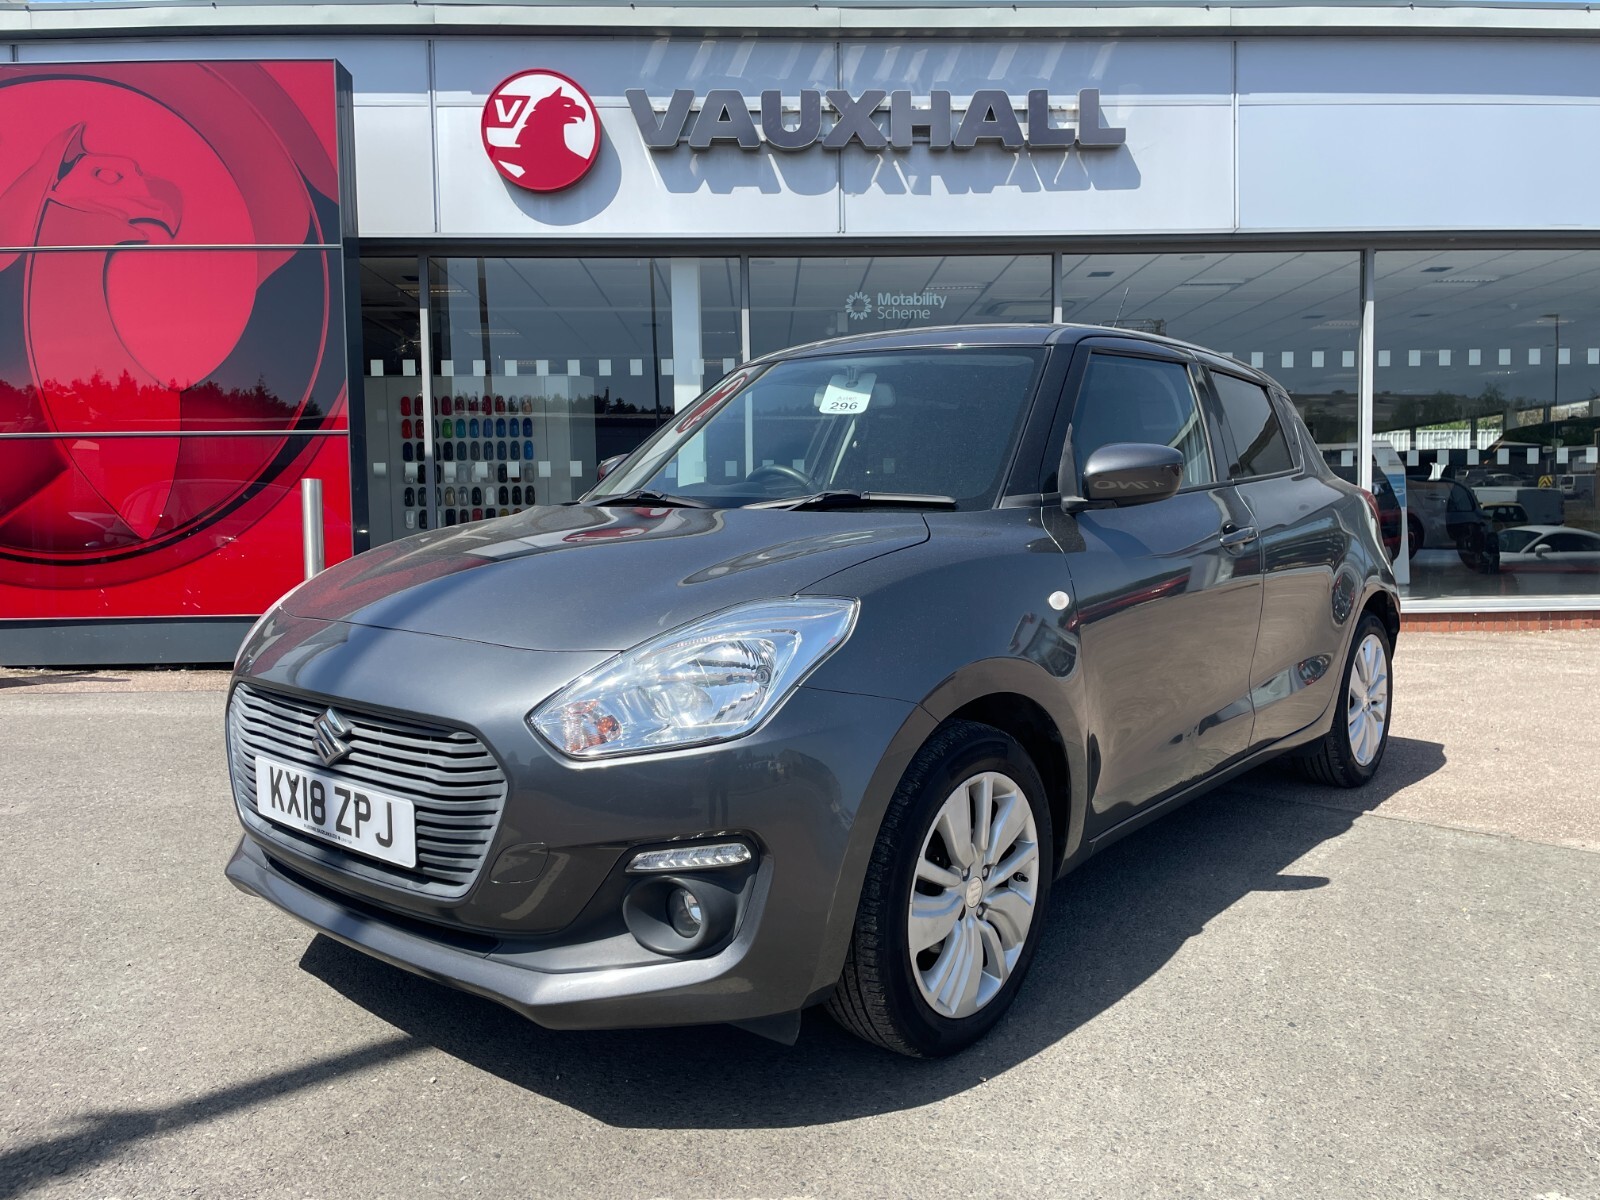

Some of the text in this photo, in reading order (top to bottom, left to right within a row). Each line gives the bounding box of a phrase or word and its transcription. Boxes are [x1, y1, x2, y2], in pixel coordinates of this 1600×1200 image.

[625, 88, 1126, 151] VAUXHALL
[877, 292, 947, 309] Motability
[877, 307, 931, 320] Scheme
[829, 401, 859, 411] 296
[269, 766, 394, 848] KX18 ZPJ
